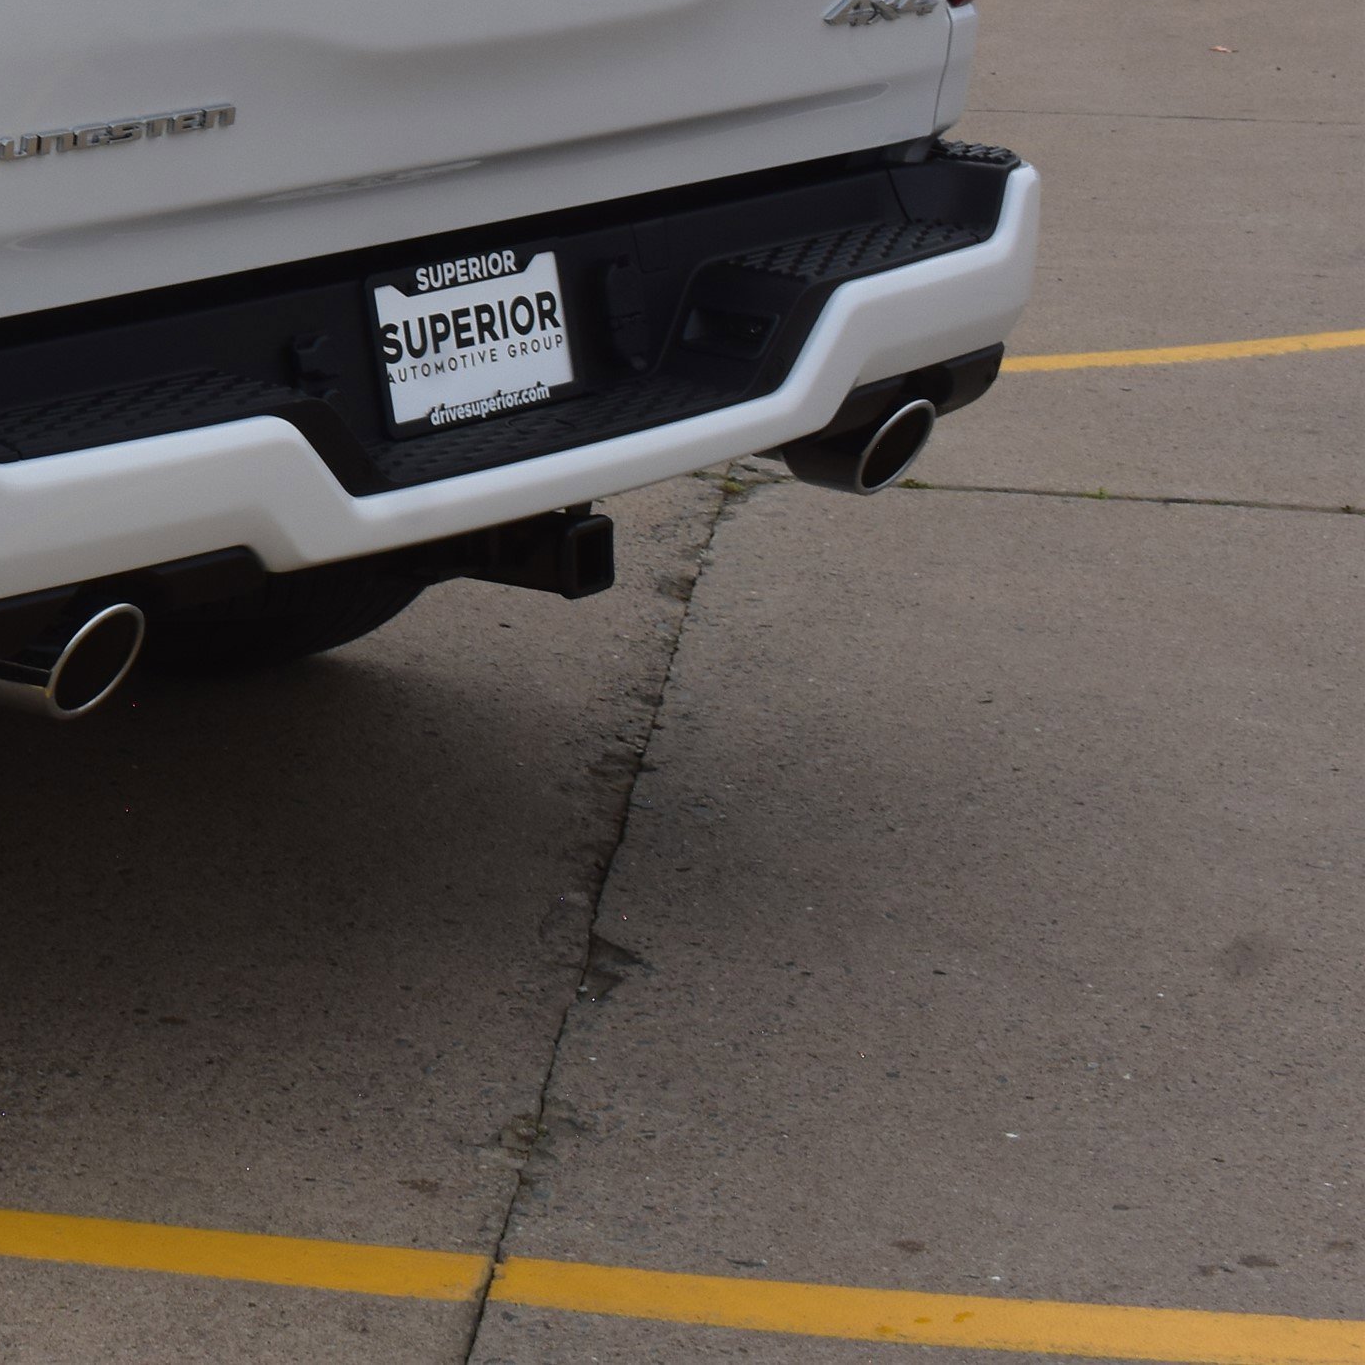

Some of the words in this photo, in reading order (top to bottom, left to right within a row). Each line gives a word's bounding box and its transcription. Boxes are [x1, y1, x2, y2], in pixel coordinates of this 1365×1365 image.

[416, 249, 518, 291] SUPERIOR
[380, 291, 562, 364] SUPERIOR
[388, 348, 498, 384] AUTOMOTIVE
[508, 335, 563, 358] GROUP
[430, 385, 551, 425] drivesuperior.com
